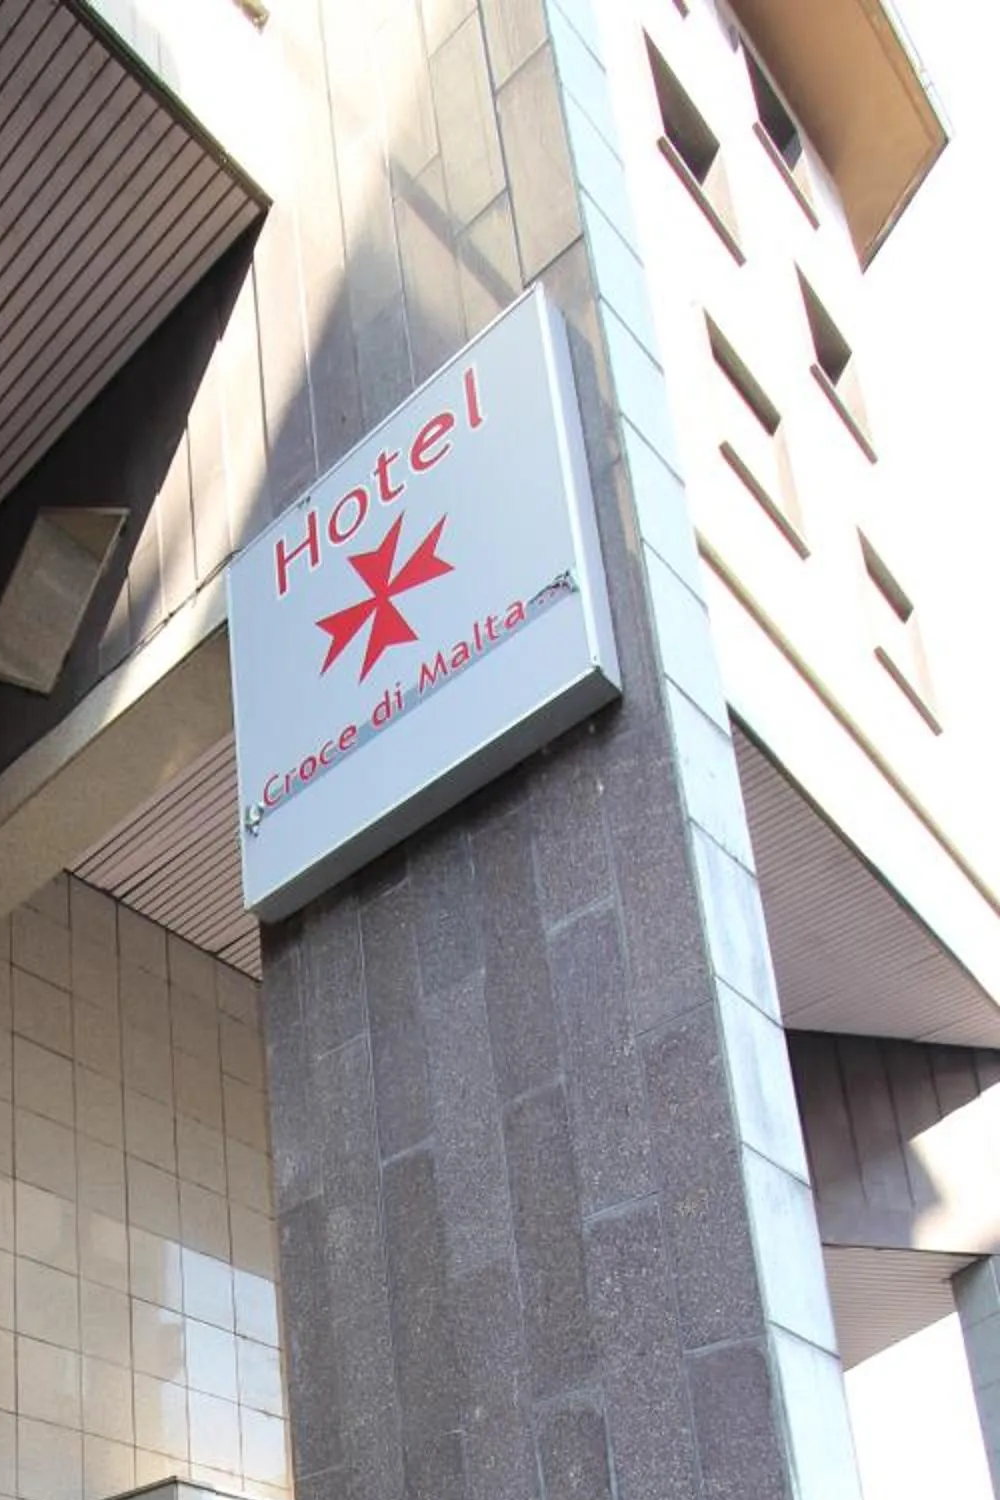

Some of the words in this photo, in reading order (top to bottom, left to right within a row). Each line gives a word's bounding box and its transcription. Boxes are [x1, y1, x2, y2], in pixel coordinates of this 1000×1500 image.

[274, 368, 485, 596] Hotel
[262, 722, 357, 807] Croce
[371, 683, 405, 728] di
[417, 598, 527, 693] Malta
